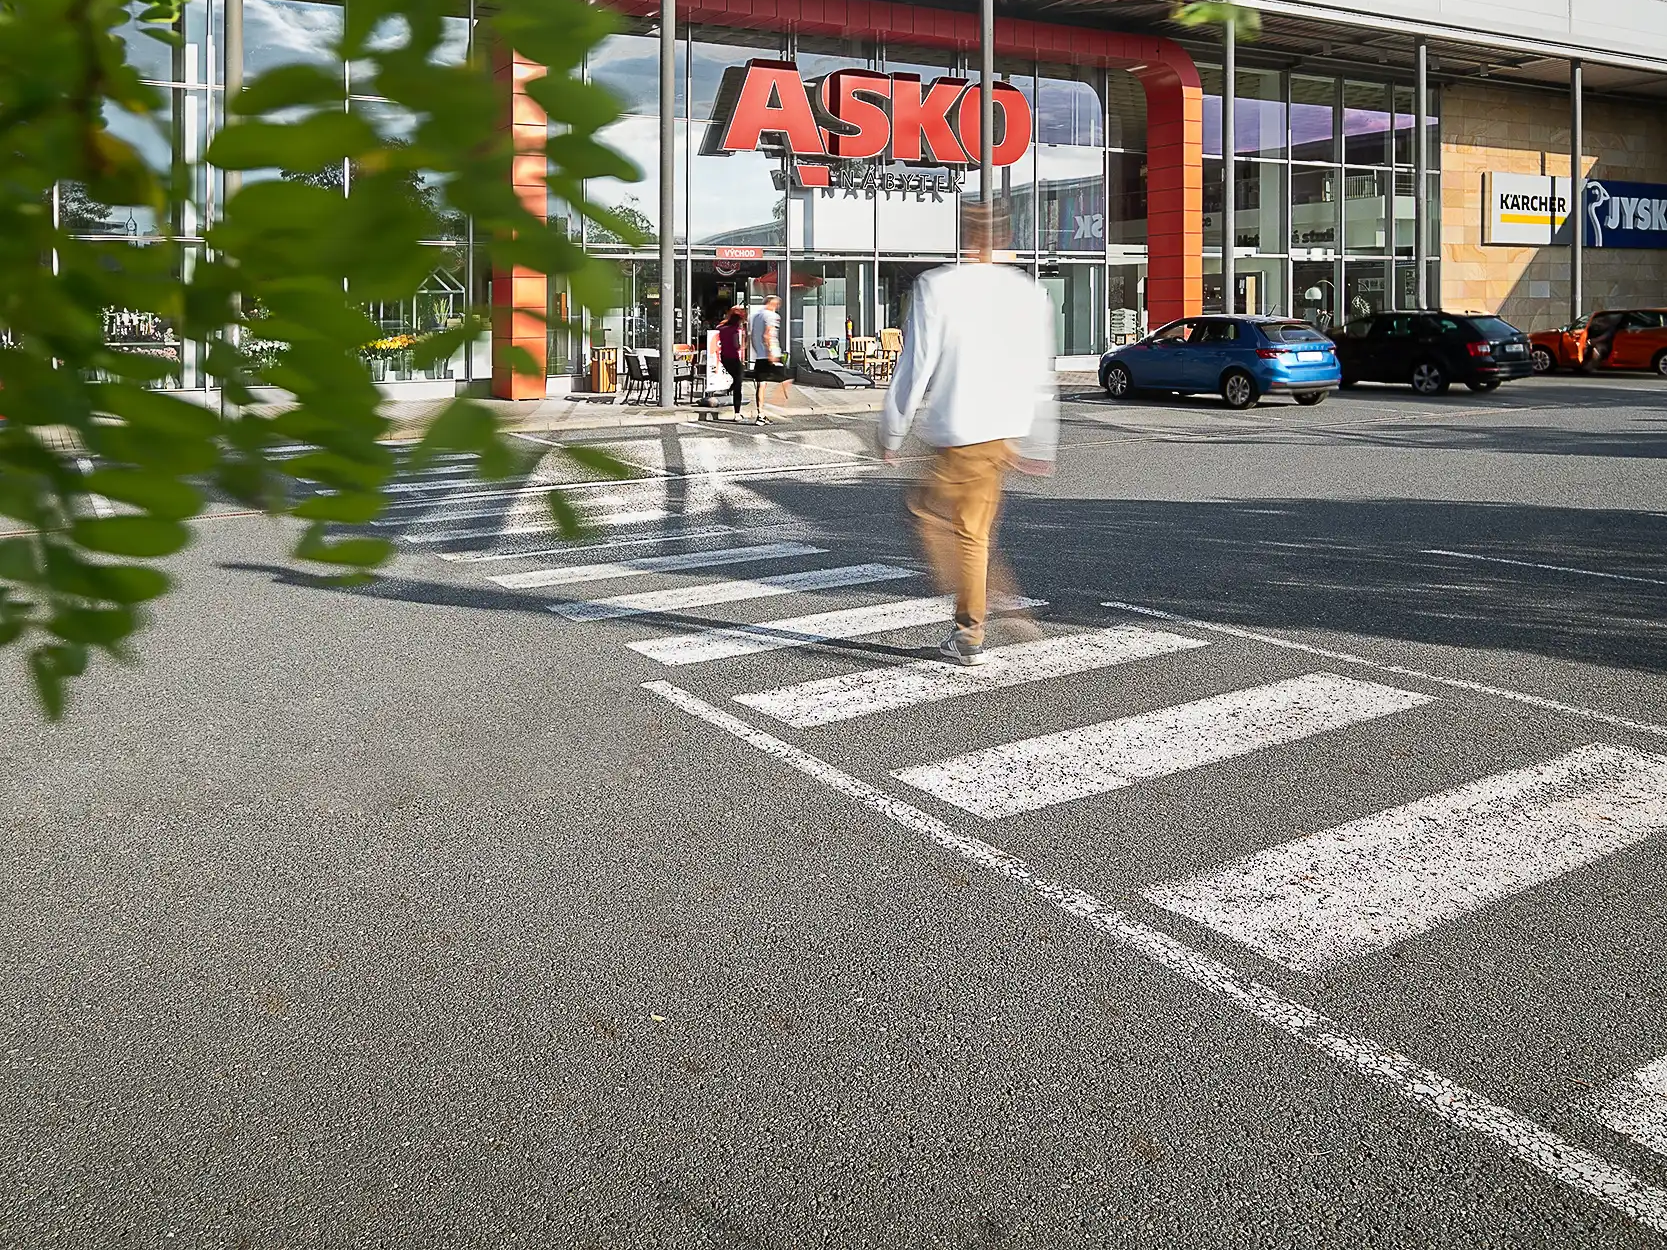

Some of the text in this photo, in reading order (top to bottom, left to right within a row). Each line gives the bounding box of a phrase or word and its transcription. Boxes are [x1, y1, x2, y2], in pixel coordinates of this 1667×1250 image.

[721, 58, 1033, 168] ASKO
[840, 165, 963, 193] NÁBYTEK
[1499, 193, 1567, 213] KÄRCHER
[1606, 196, 1667, 231] JYSK
[724, 247, 756, 258] VÝCHOD
